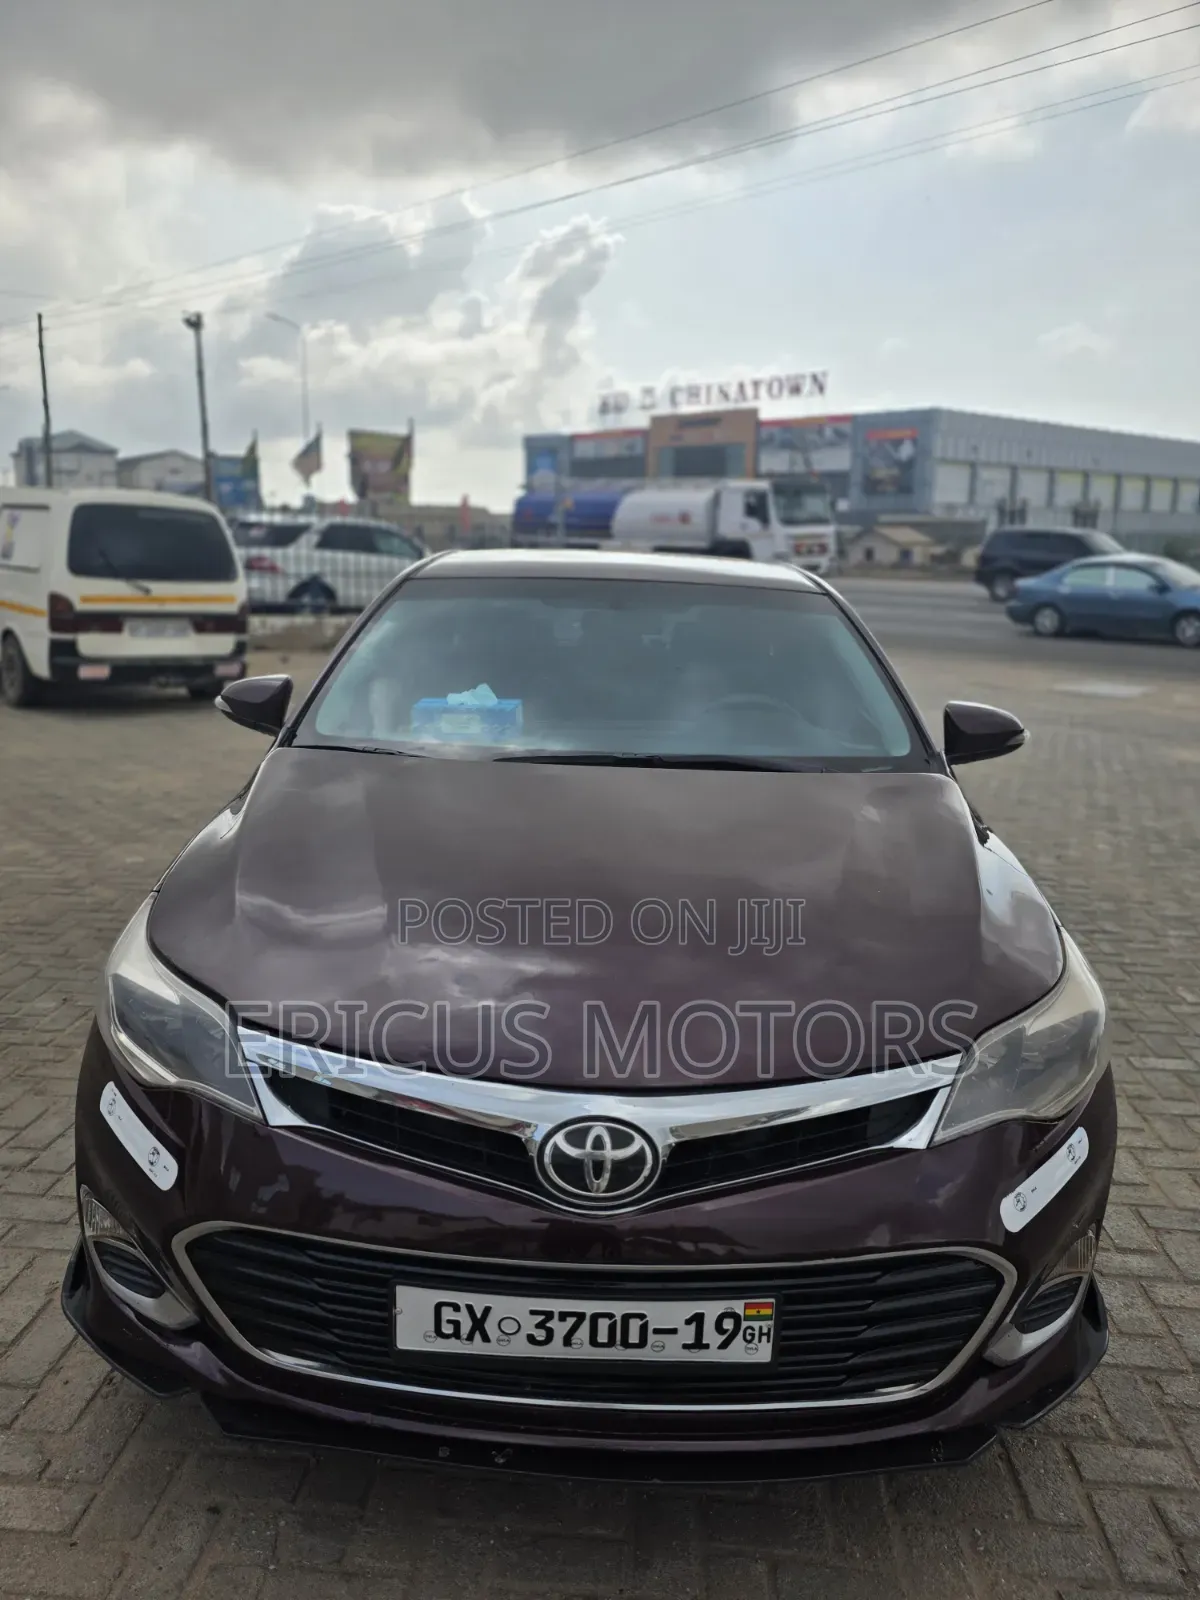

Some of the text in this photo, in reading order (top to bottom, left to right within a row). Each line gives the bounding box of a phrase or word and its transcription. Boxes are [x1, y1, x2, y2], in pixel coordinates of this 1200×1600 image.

[671, 370, 828, 409] CHINATOWN
[434, 1301, 742, 1350] GX 3700-19
[743, 1325, 772, 1344] GH
